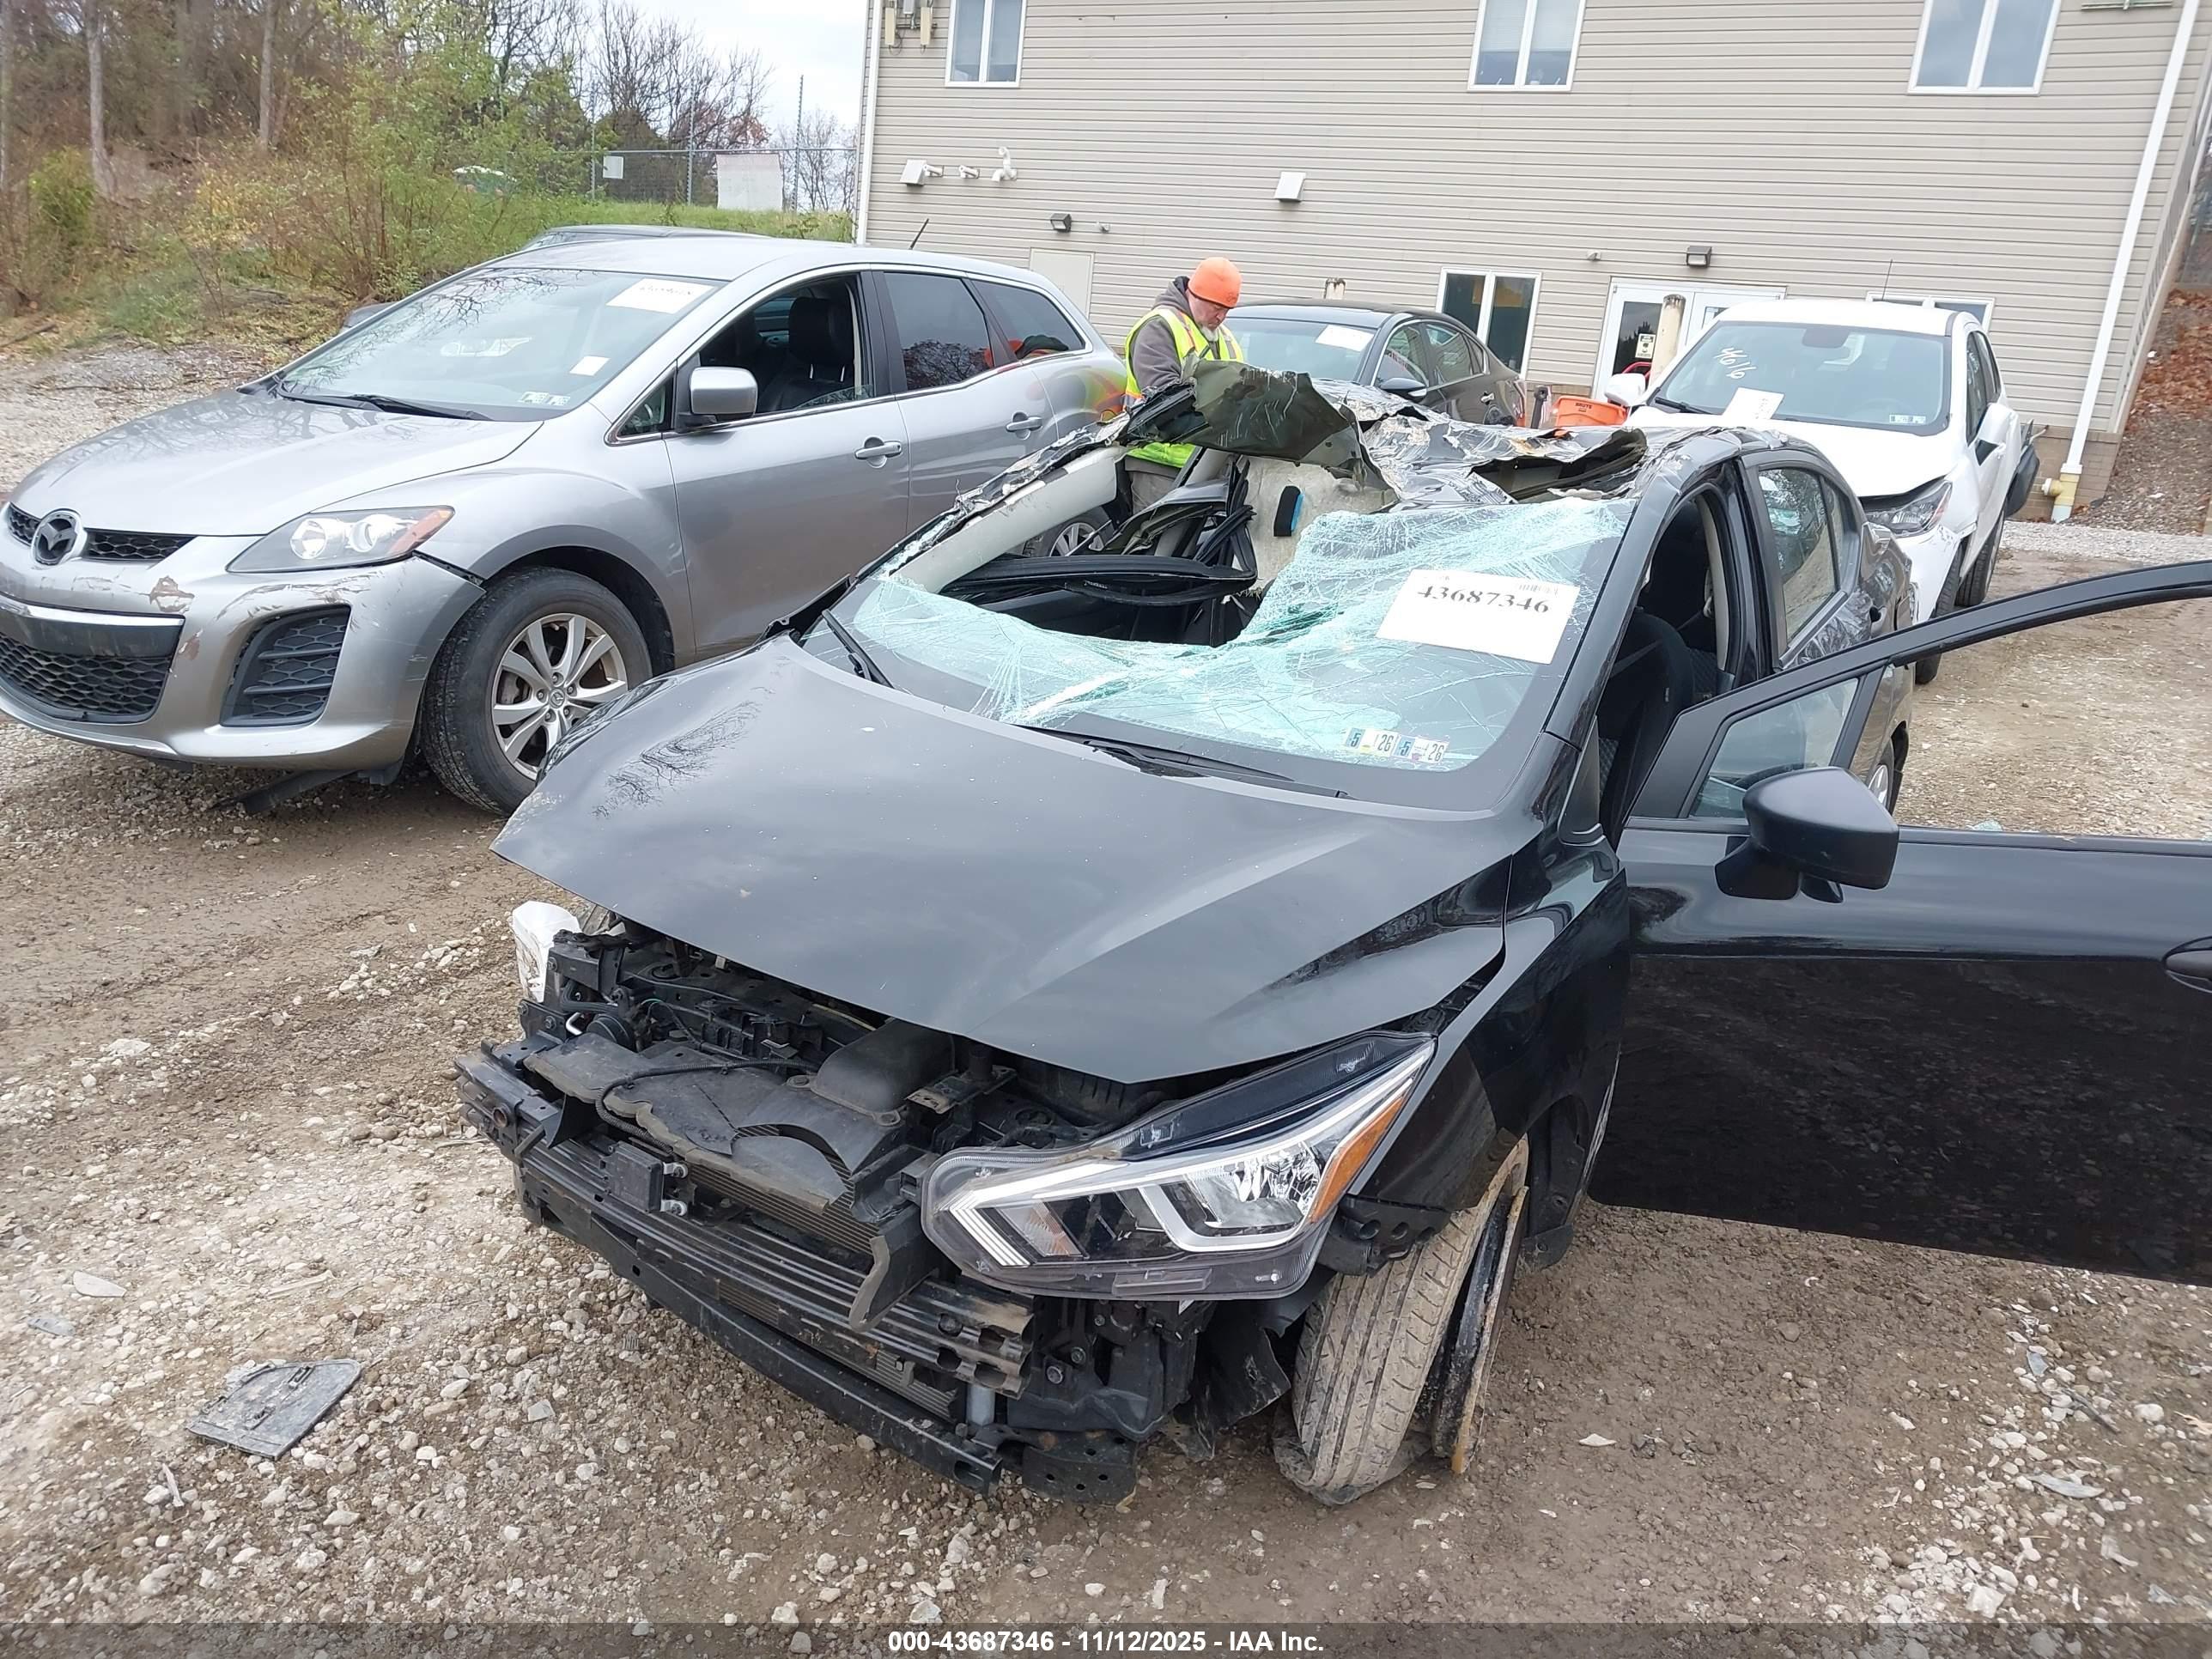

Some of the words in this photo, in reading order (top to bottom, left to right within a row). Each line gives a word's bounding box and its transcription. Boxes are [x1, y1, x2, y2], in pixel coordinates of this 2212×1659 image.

[1417, 585, 1550, 613] 43687346
[1377, 734, 1395, 752] 26
[1428, 744, 1444, 762] 26
